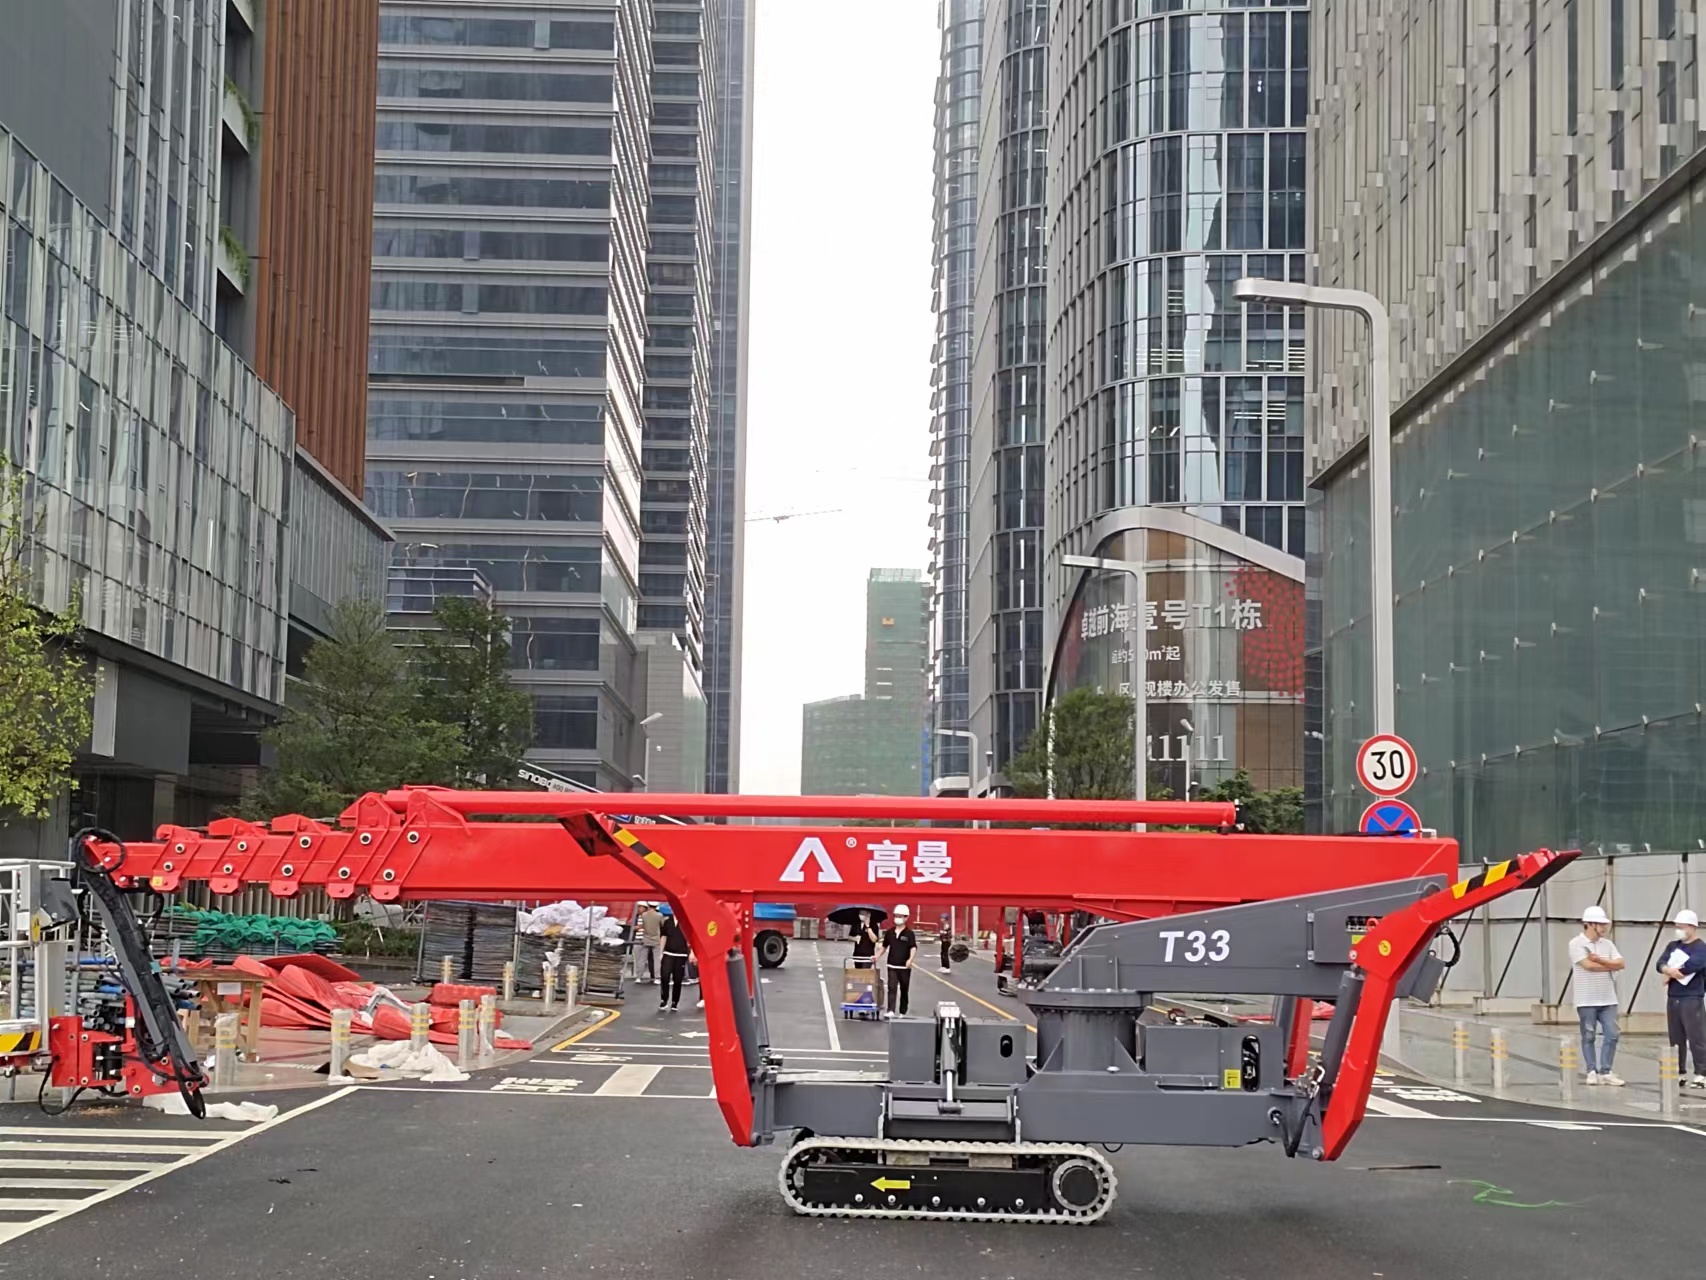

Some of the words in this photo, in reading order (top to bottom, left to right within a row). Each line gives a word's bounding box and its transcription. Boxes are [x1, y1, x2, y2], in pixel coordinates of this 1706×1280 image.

[1371, 750, 1405, 780] 30
[867, 839, 953, 884] 高曼
[1159, 929, 1230, 962] T33
